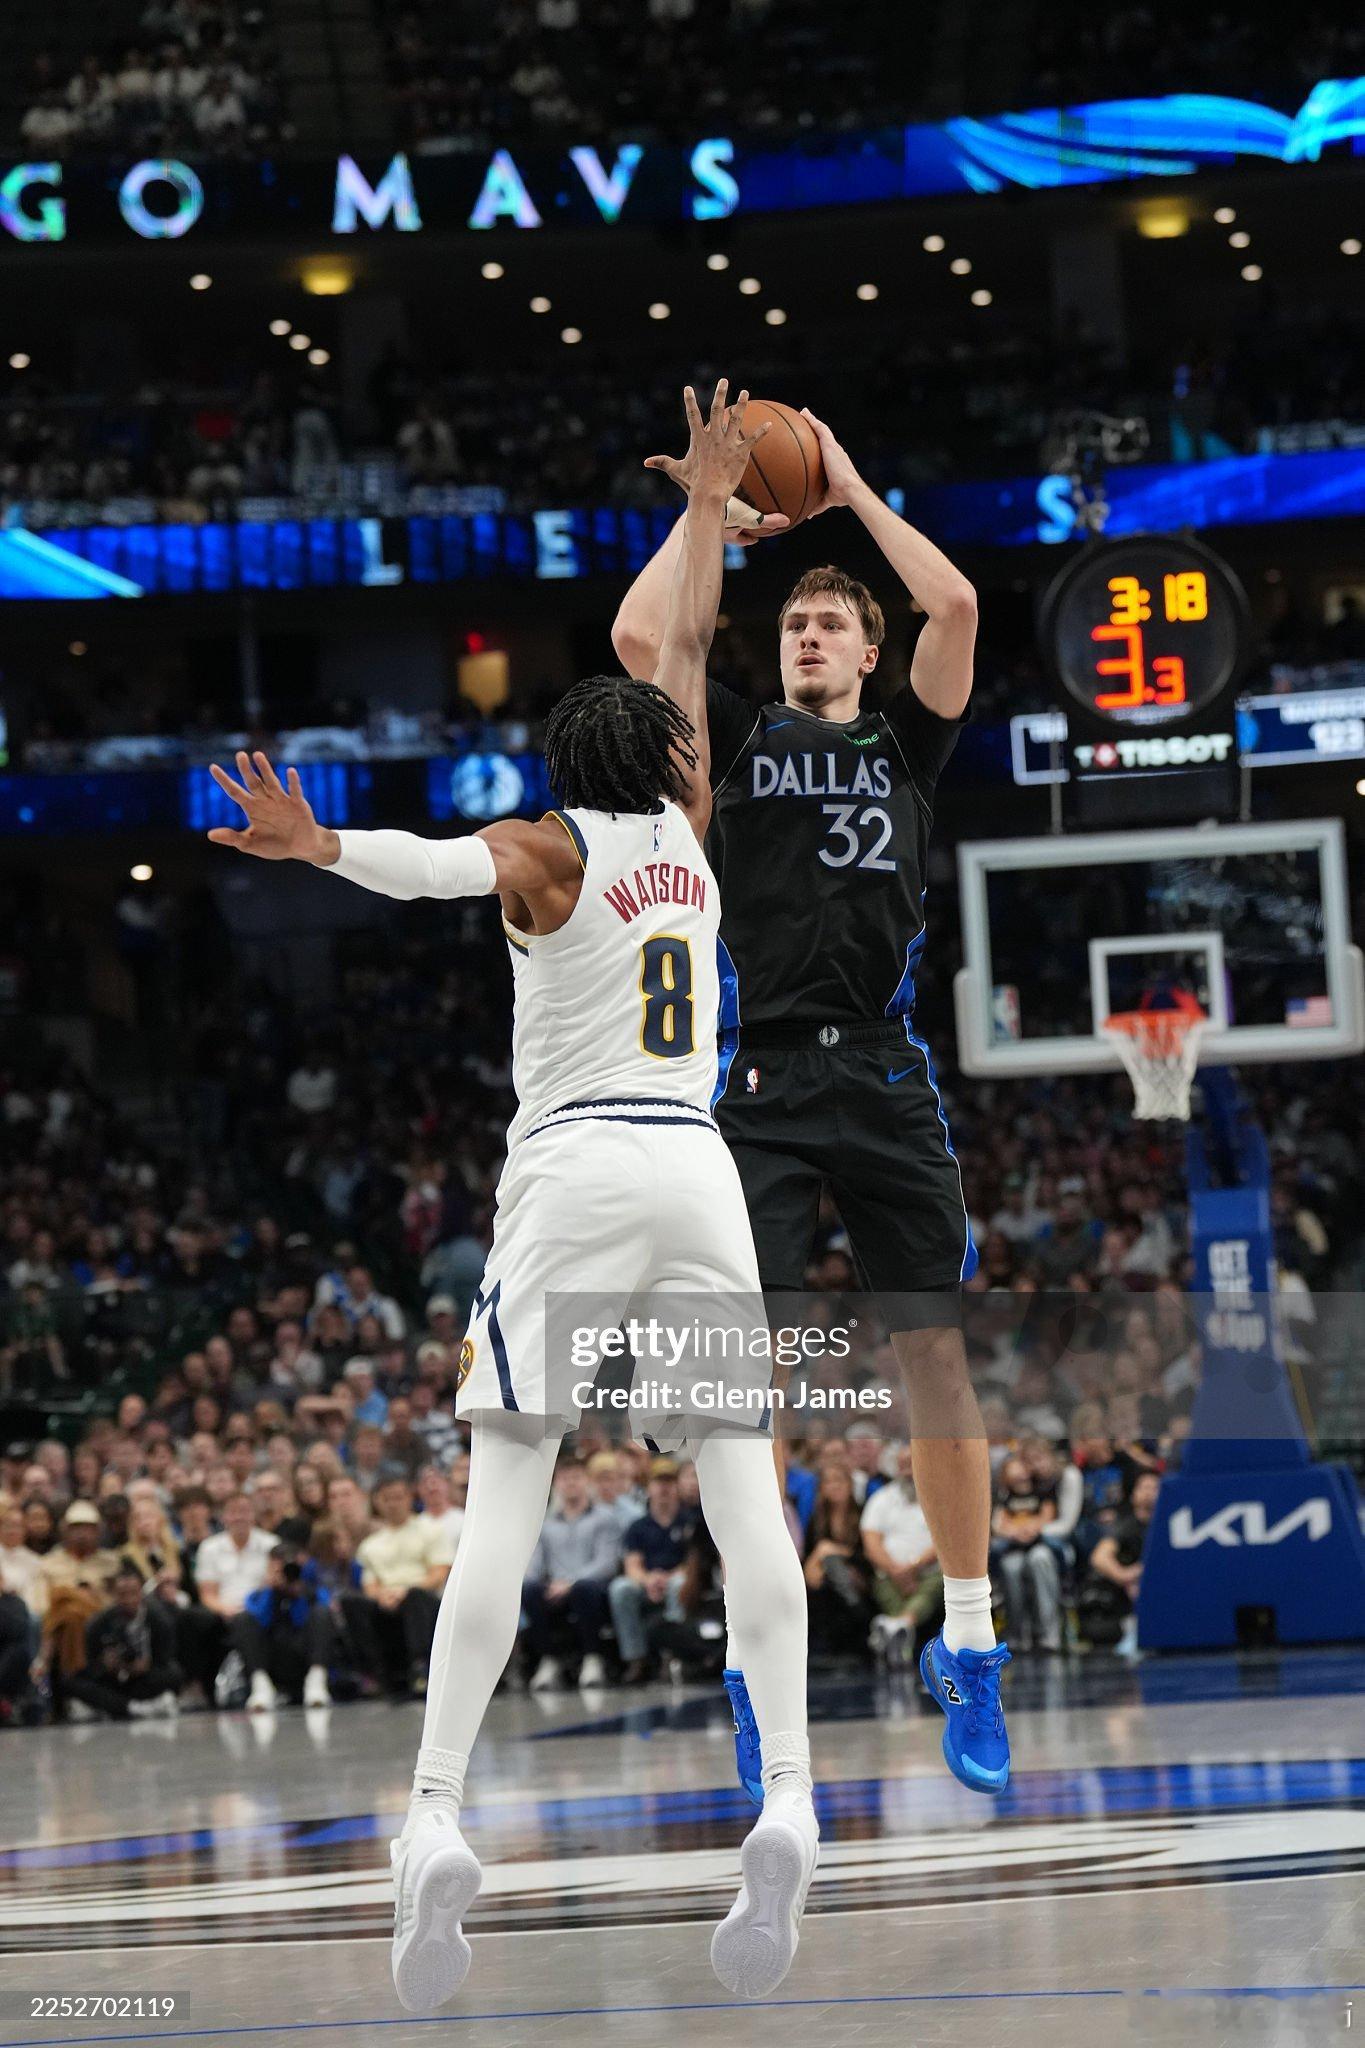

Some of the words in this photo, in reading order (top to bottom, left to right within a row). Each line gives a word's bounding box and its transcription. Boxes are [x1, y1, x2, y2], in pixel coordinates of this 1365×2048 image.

[0, 159, 204, 241] GO
[331, 138, 740, 234] MAVS
[1108, 571, 1208, 625] 3:18
[751, 752, 891, 799] DALLAS
[1115, 733, 1233, 767] TISSOT
[817, 804, 896, 871] 32
[603, 863, 705, 924] WATSON
[639, 933, 696, 1060] 8
